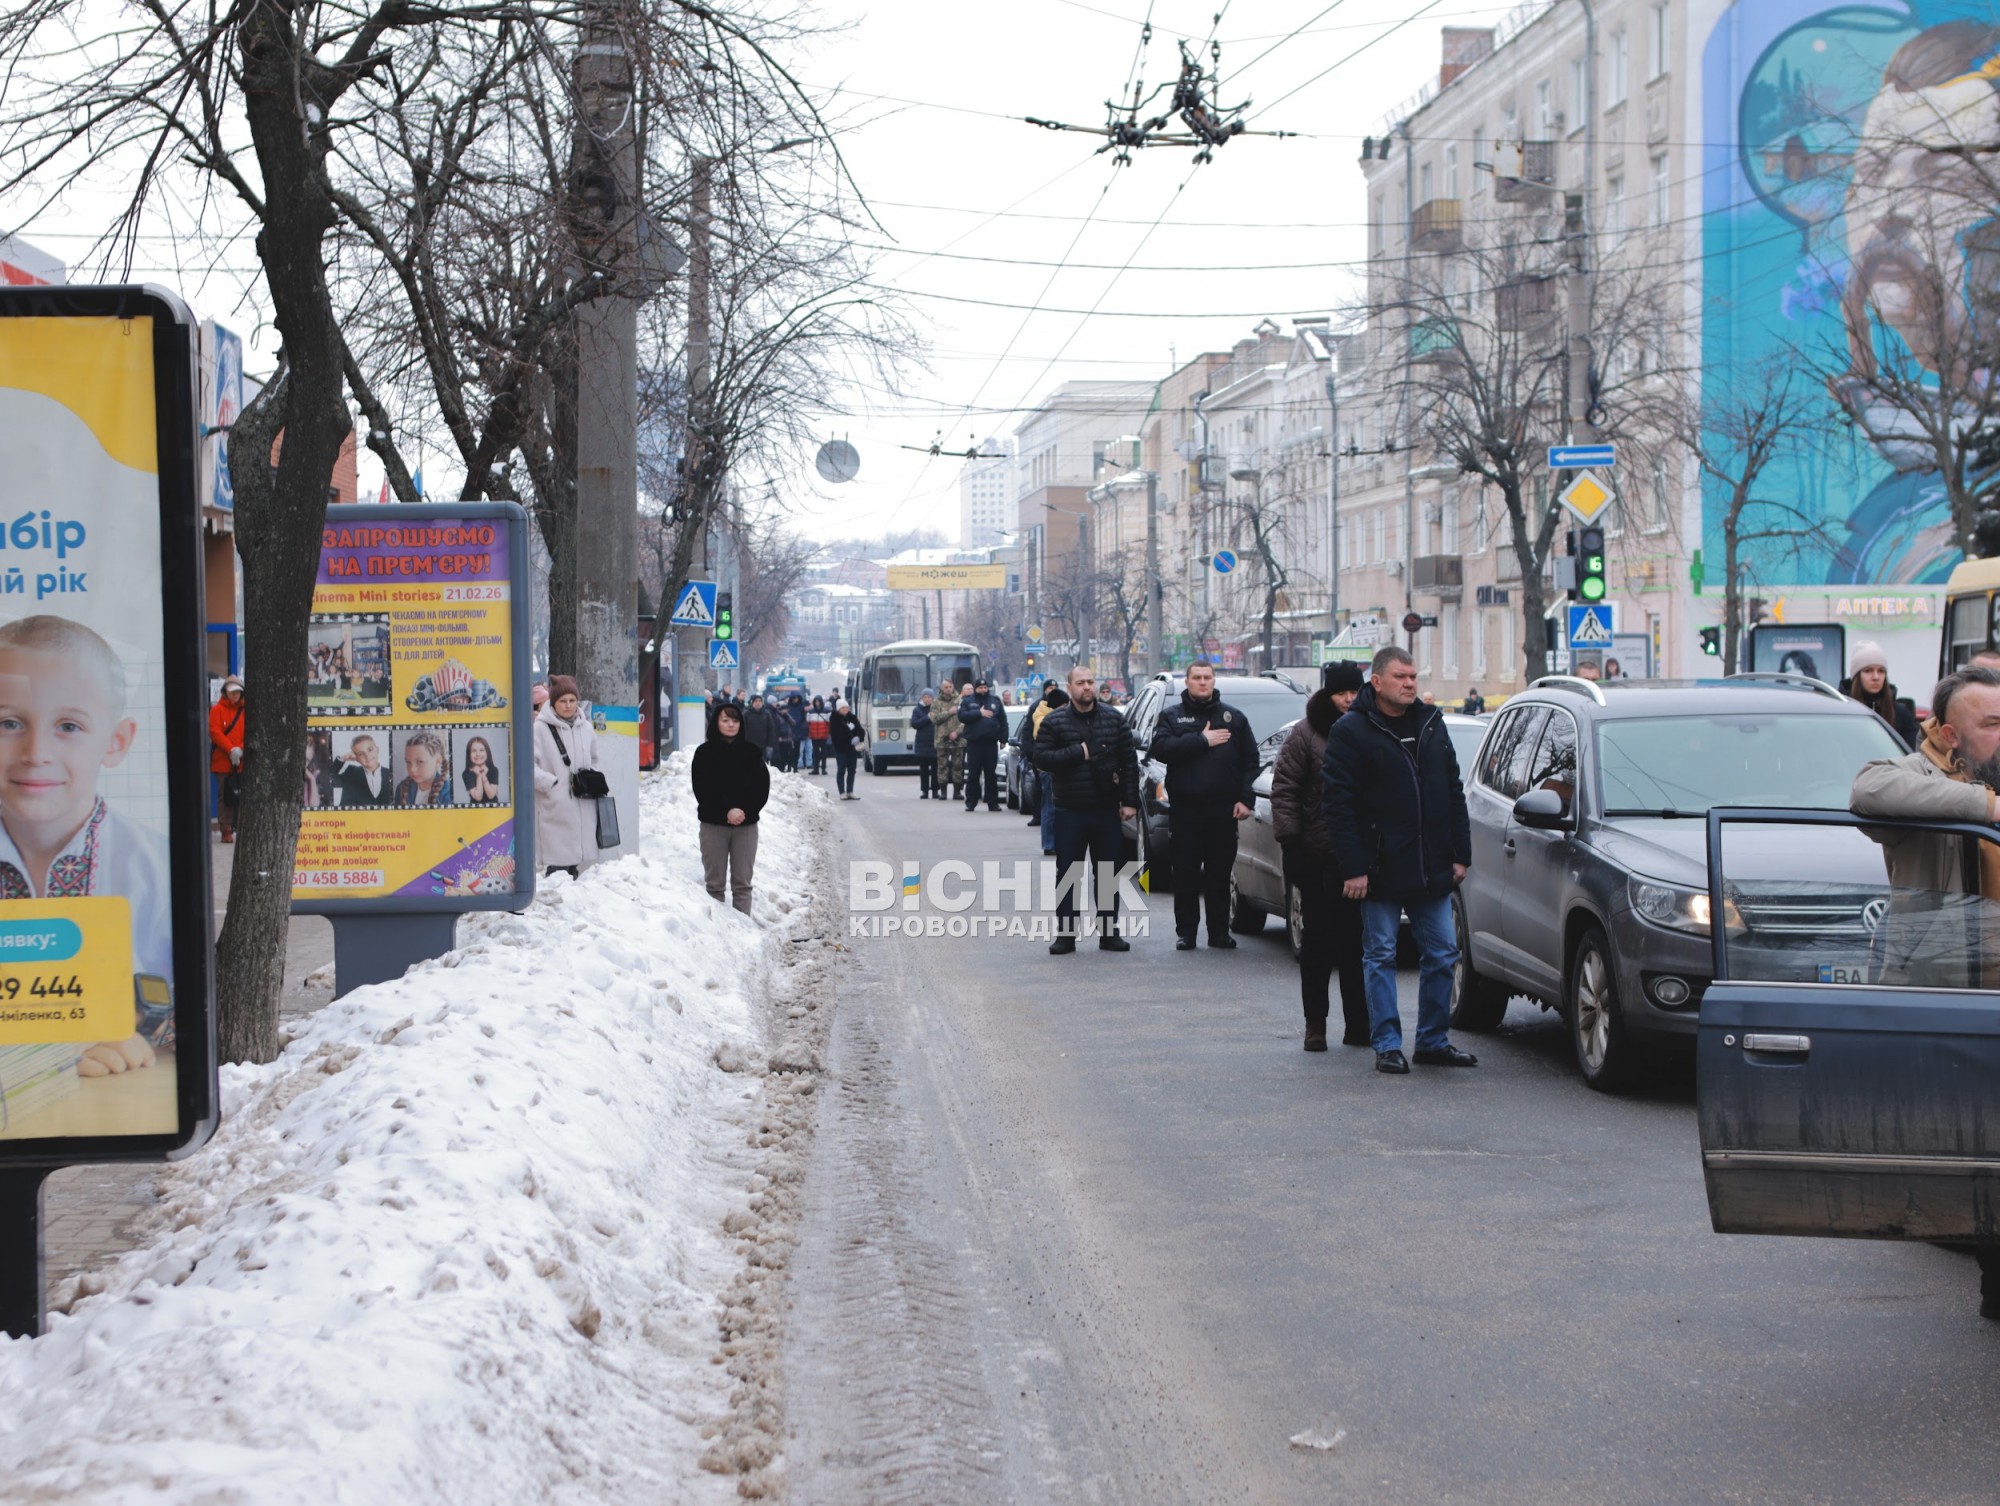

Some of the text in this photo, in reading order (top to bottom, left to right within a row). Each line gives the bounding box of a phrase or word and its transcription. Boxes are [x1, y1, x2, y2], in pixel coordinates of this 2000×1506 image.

[0, 510, 86, 559] бір
[322, 526, 495, 548] ЗАПРОШУЄМО
[327, 553, 491, 577] НА ПРЕМ'ЄРУ!
[0, 565, 88, 600] й рік
[359, 589, 387, 602] Mini
[392, 589, 442, 601] stories»
[446, 587, 502, 600] 21.02.26
[1835, 597, 1930, 615] АПТЕКА
[392, 611, 426, 620] ЧЕКАЄМО
[427, 610, 437, 619] НА
[392, 624, 419, 633] ПОКАЗІ
[392, 635, 502, 647] СТВОРЕНИХ АКТОРАМИ-ДІТЬМИ
[393, 650, 402, 660] ТА
[404, 650, 420, 660] ДЛЯ
[314, 820, 346, 828] актори
[345, 830, 410, 842] кінофестивалі
[316, 844, 329, 853] які
[322, 858, 340, 867] для
[343, 855, 379, 867] довідок
[312, 871, 338, 885] 458
[343, 870, 378, 884] 5884
[0, 933, 57, 951] явку:
[0, 975, 83, 1000] 9 444
[70, 1008, 86, 1019] 63
